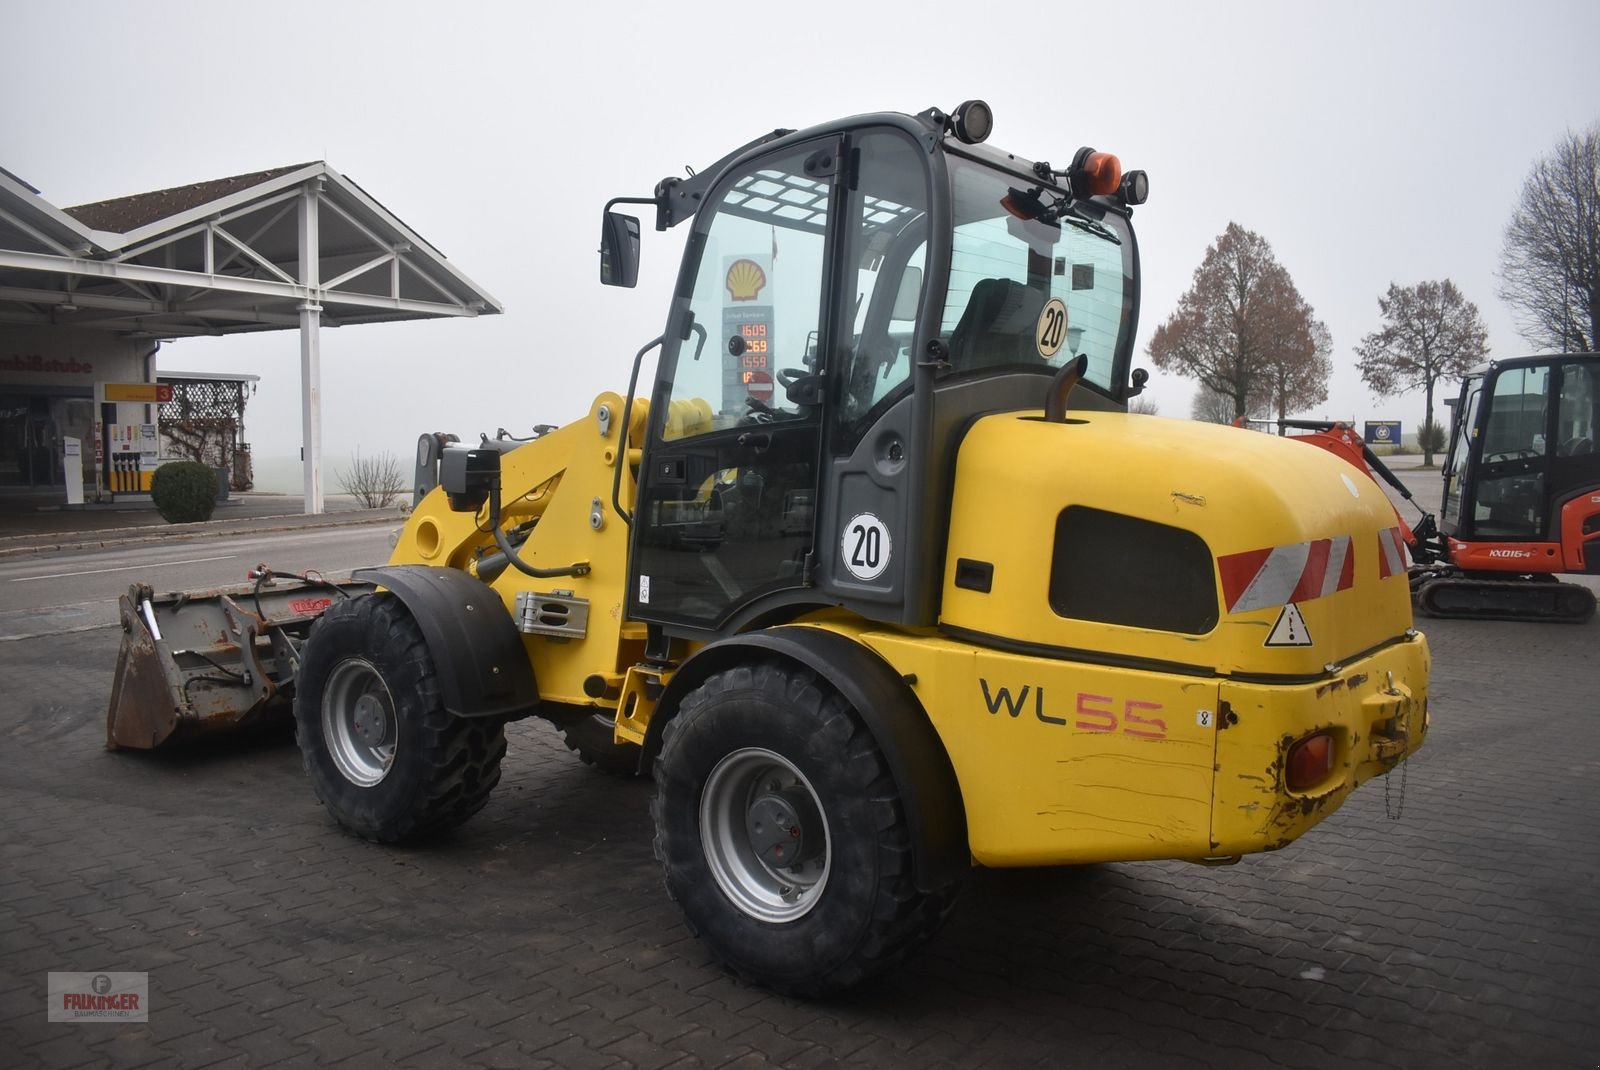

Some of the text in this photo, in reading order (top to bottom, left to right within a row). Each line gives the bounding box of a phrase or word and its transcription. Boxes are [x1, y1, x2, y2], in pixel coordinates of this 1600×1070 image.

[743, 324, 766, 336] 1609
[1041, 307, 1064, 348] 20
[160, 389, 169, 400] 3
[851, 524, 881, 568] 20
